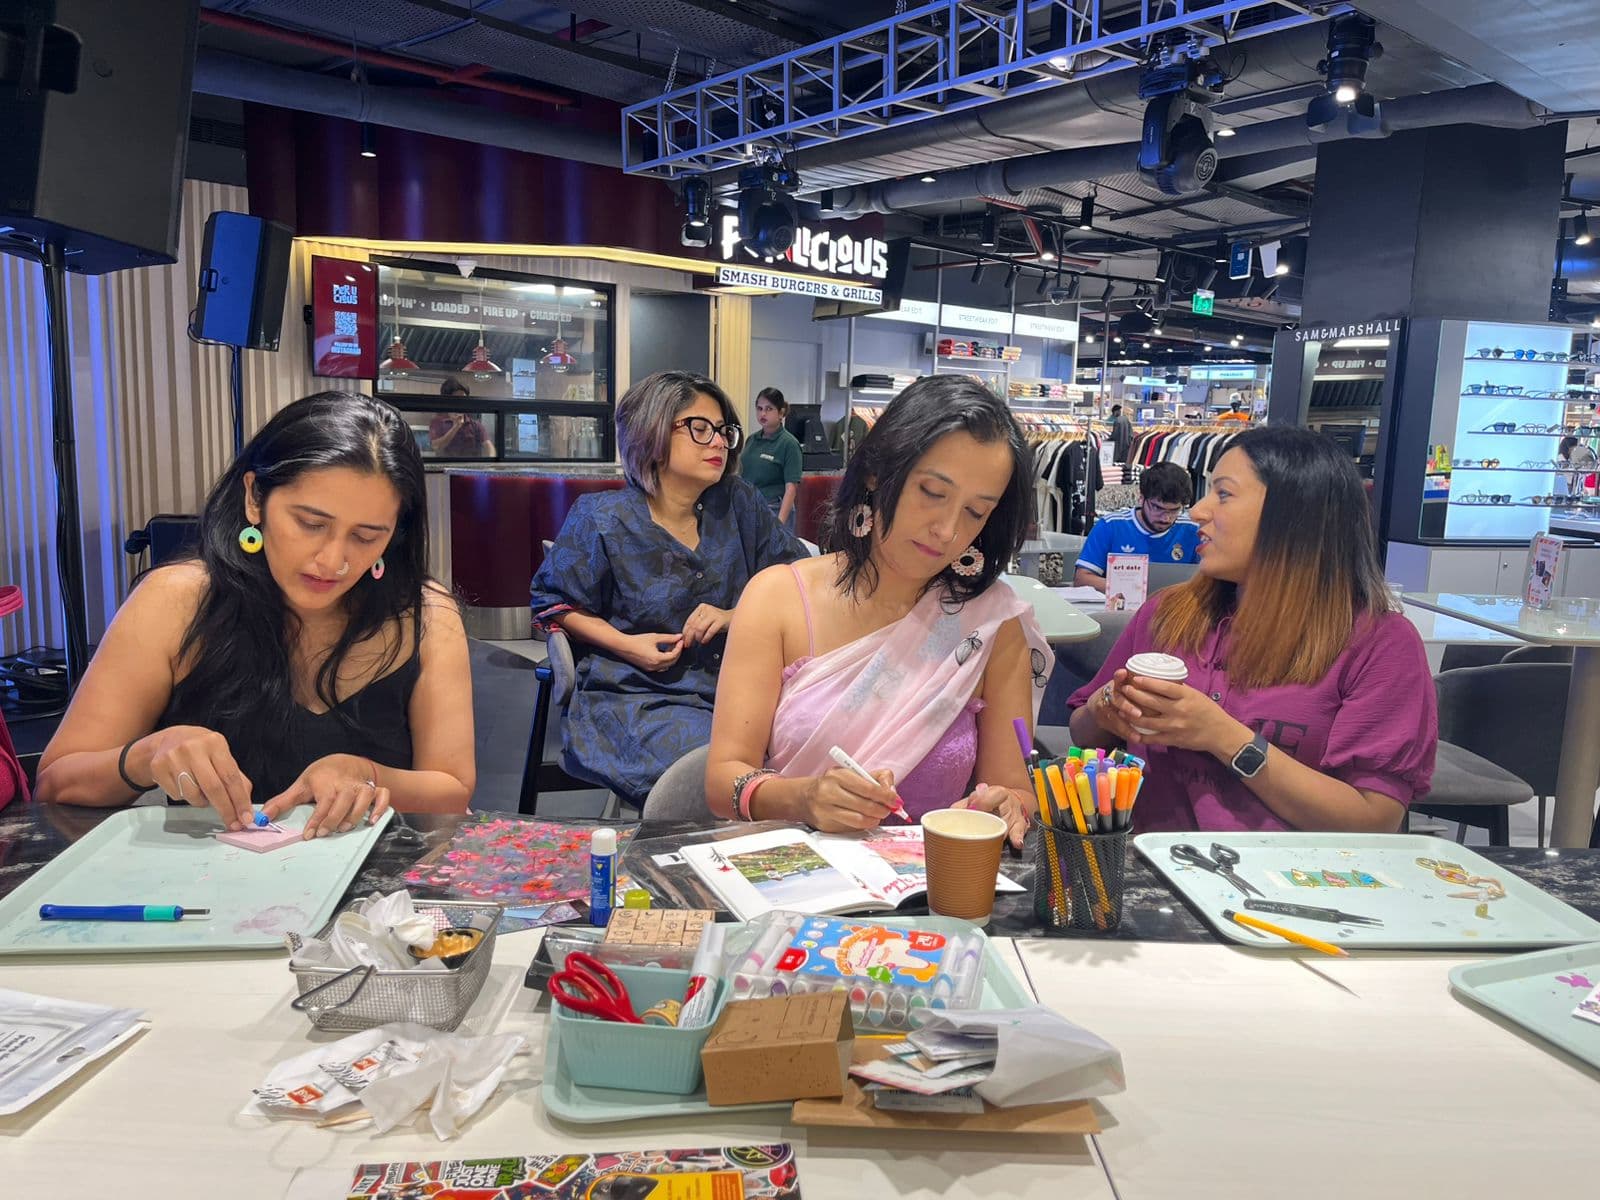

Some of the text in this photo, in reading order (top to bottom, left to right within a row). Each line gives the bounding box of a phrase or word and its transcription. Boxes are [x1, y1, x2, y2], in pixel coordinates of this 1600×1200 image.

[722, 269, 881, 302] SMASH BURGERS & GRILLS
[431, 301, 470, 314] LOADED
[483, 306, 504, 317] FIRE
[505, 308, 518, 318] UP
[1295, 319, 1401, 342] SAM&MARSHALL
[455, 1163, 475, 1187] JUST
[472, 1163, 488, 1188] ONE
[485, 1163, 501, 1187] MORE
